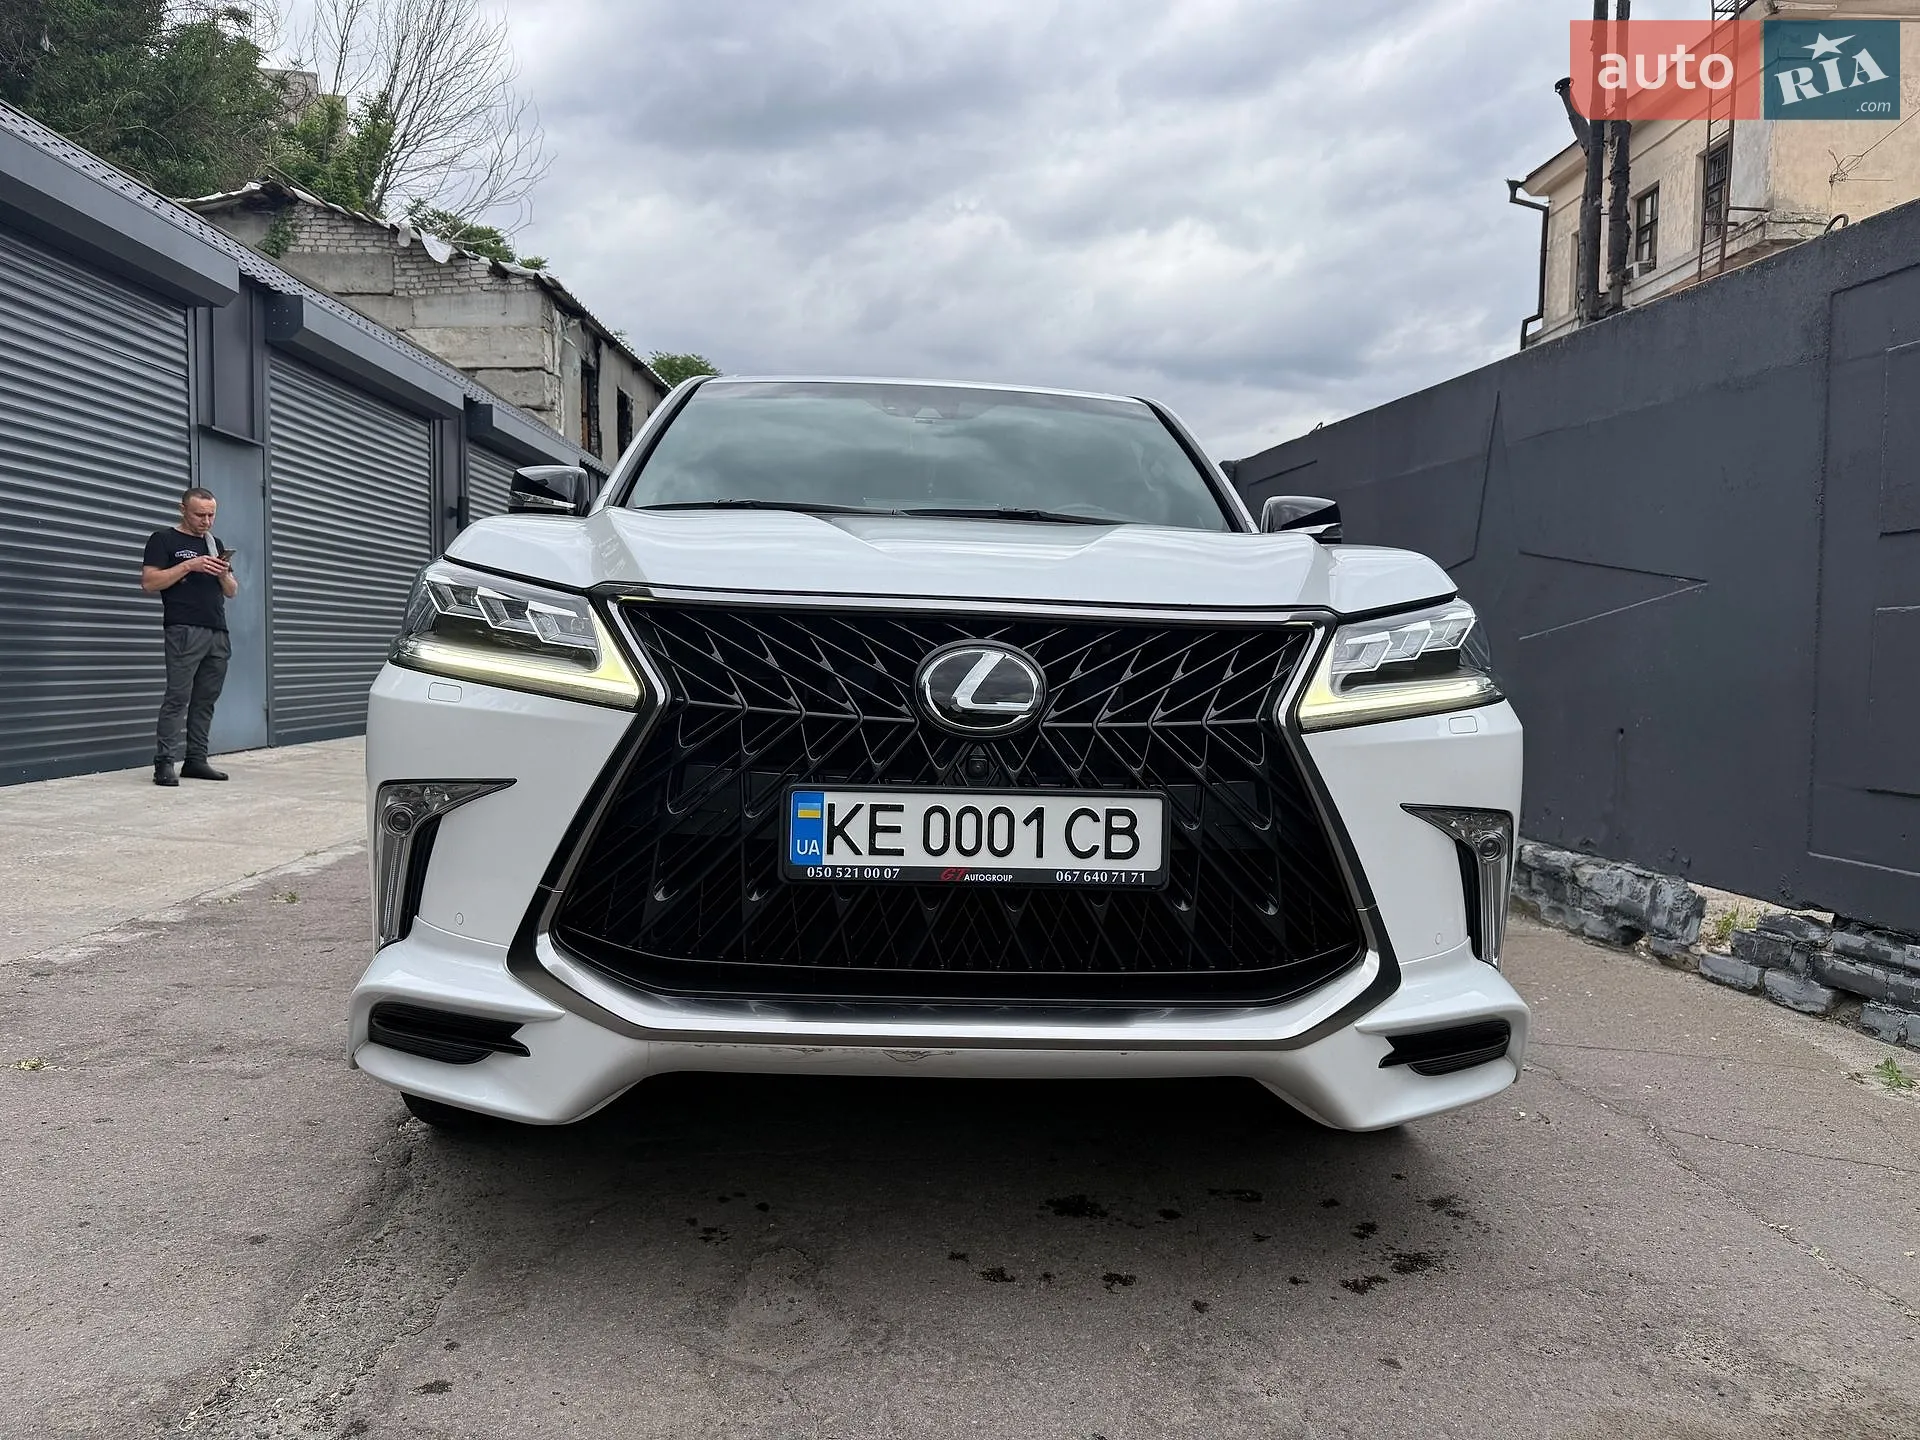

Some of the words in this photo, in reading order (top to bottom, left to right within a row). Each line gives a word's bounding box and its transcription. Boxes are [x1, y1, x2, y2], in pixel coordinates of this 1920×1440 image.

[826, 802, 905, 856] KE
[922, 804, 1045, 859] 0001
[1064, 806, 1141, 860] CB
[796, 839, 821, 856] UA
[807, 866, 832, 878] 050
[835, 867, 859, 879] 521
[864, 867, 880, 879] 00
[883, 867, 900, 879] 07
[964, 873, 1013, 882] AUTOGROUP
[1056, 870, 1080, 882] 067
[1083, 871, 1108, 883] 640
[1111, 871, 1126, 883] 71
[1131, 872, 1145, 883] 71
